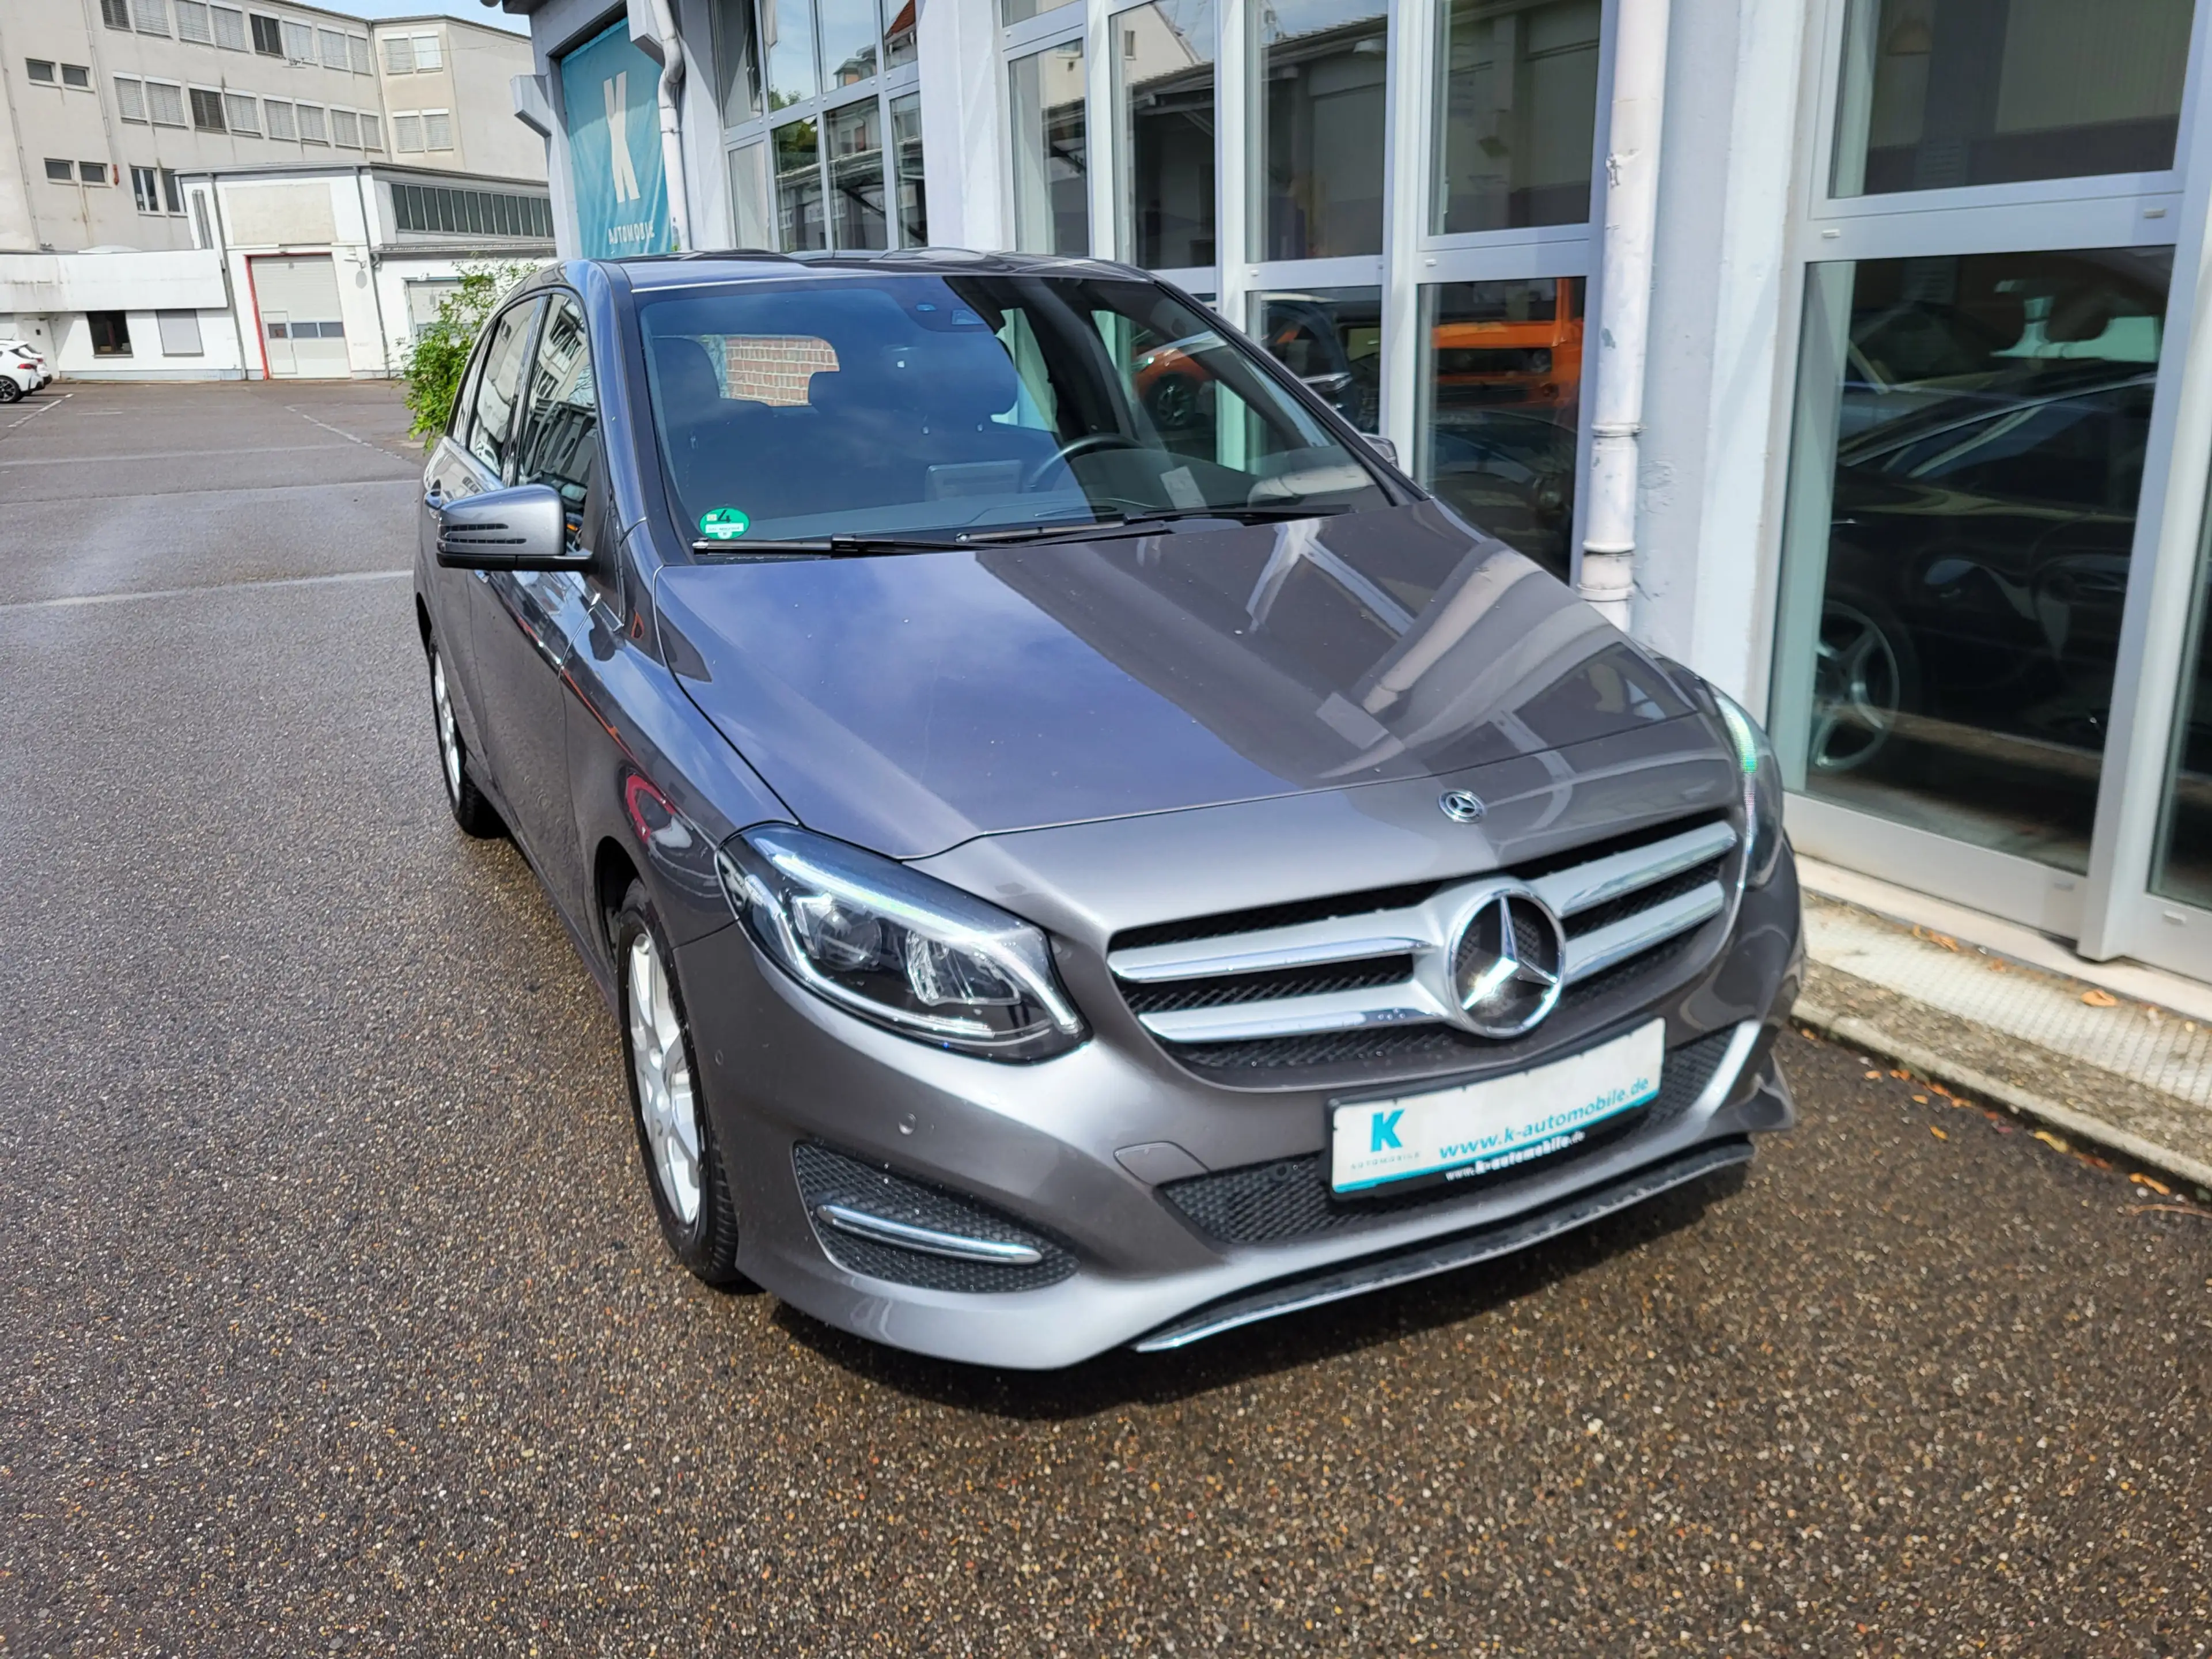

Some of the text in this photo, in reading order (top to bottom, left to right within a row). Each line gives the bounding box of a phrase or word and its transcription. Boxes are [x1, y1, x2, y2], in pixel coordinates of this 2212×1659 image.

[604, 71, 641, 203] K
[718, 509, 732, 523] 4
[1370, 1108, 1406, 1153] K
[1439, 1076, 1649, 1159] www.k-automobile.de
[1445, 1131, 1586, 1181] www.k-automobile.de
